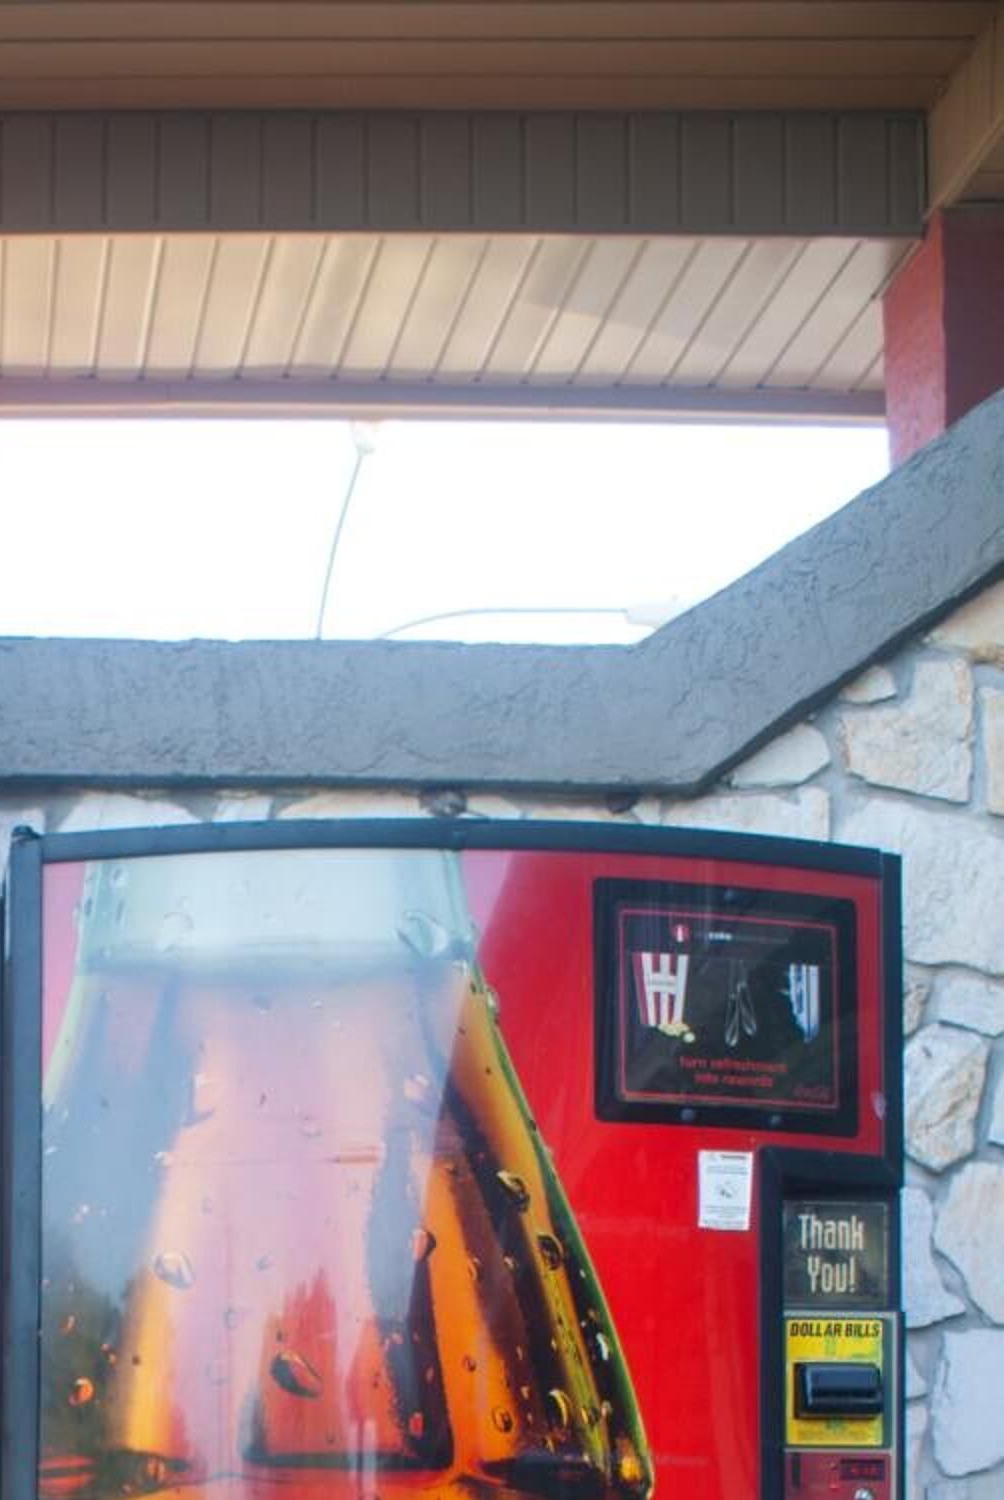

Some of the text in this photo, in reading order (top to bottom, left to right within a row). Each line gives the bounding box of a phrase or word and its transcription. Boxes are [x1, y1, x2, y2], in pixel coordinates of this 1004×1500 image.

[798, 1214, 865, 1250] Thank
[808, 1256, 856, 1293] You!
[789, 1323, 880, 1338] DOLLAR BILLS
